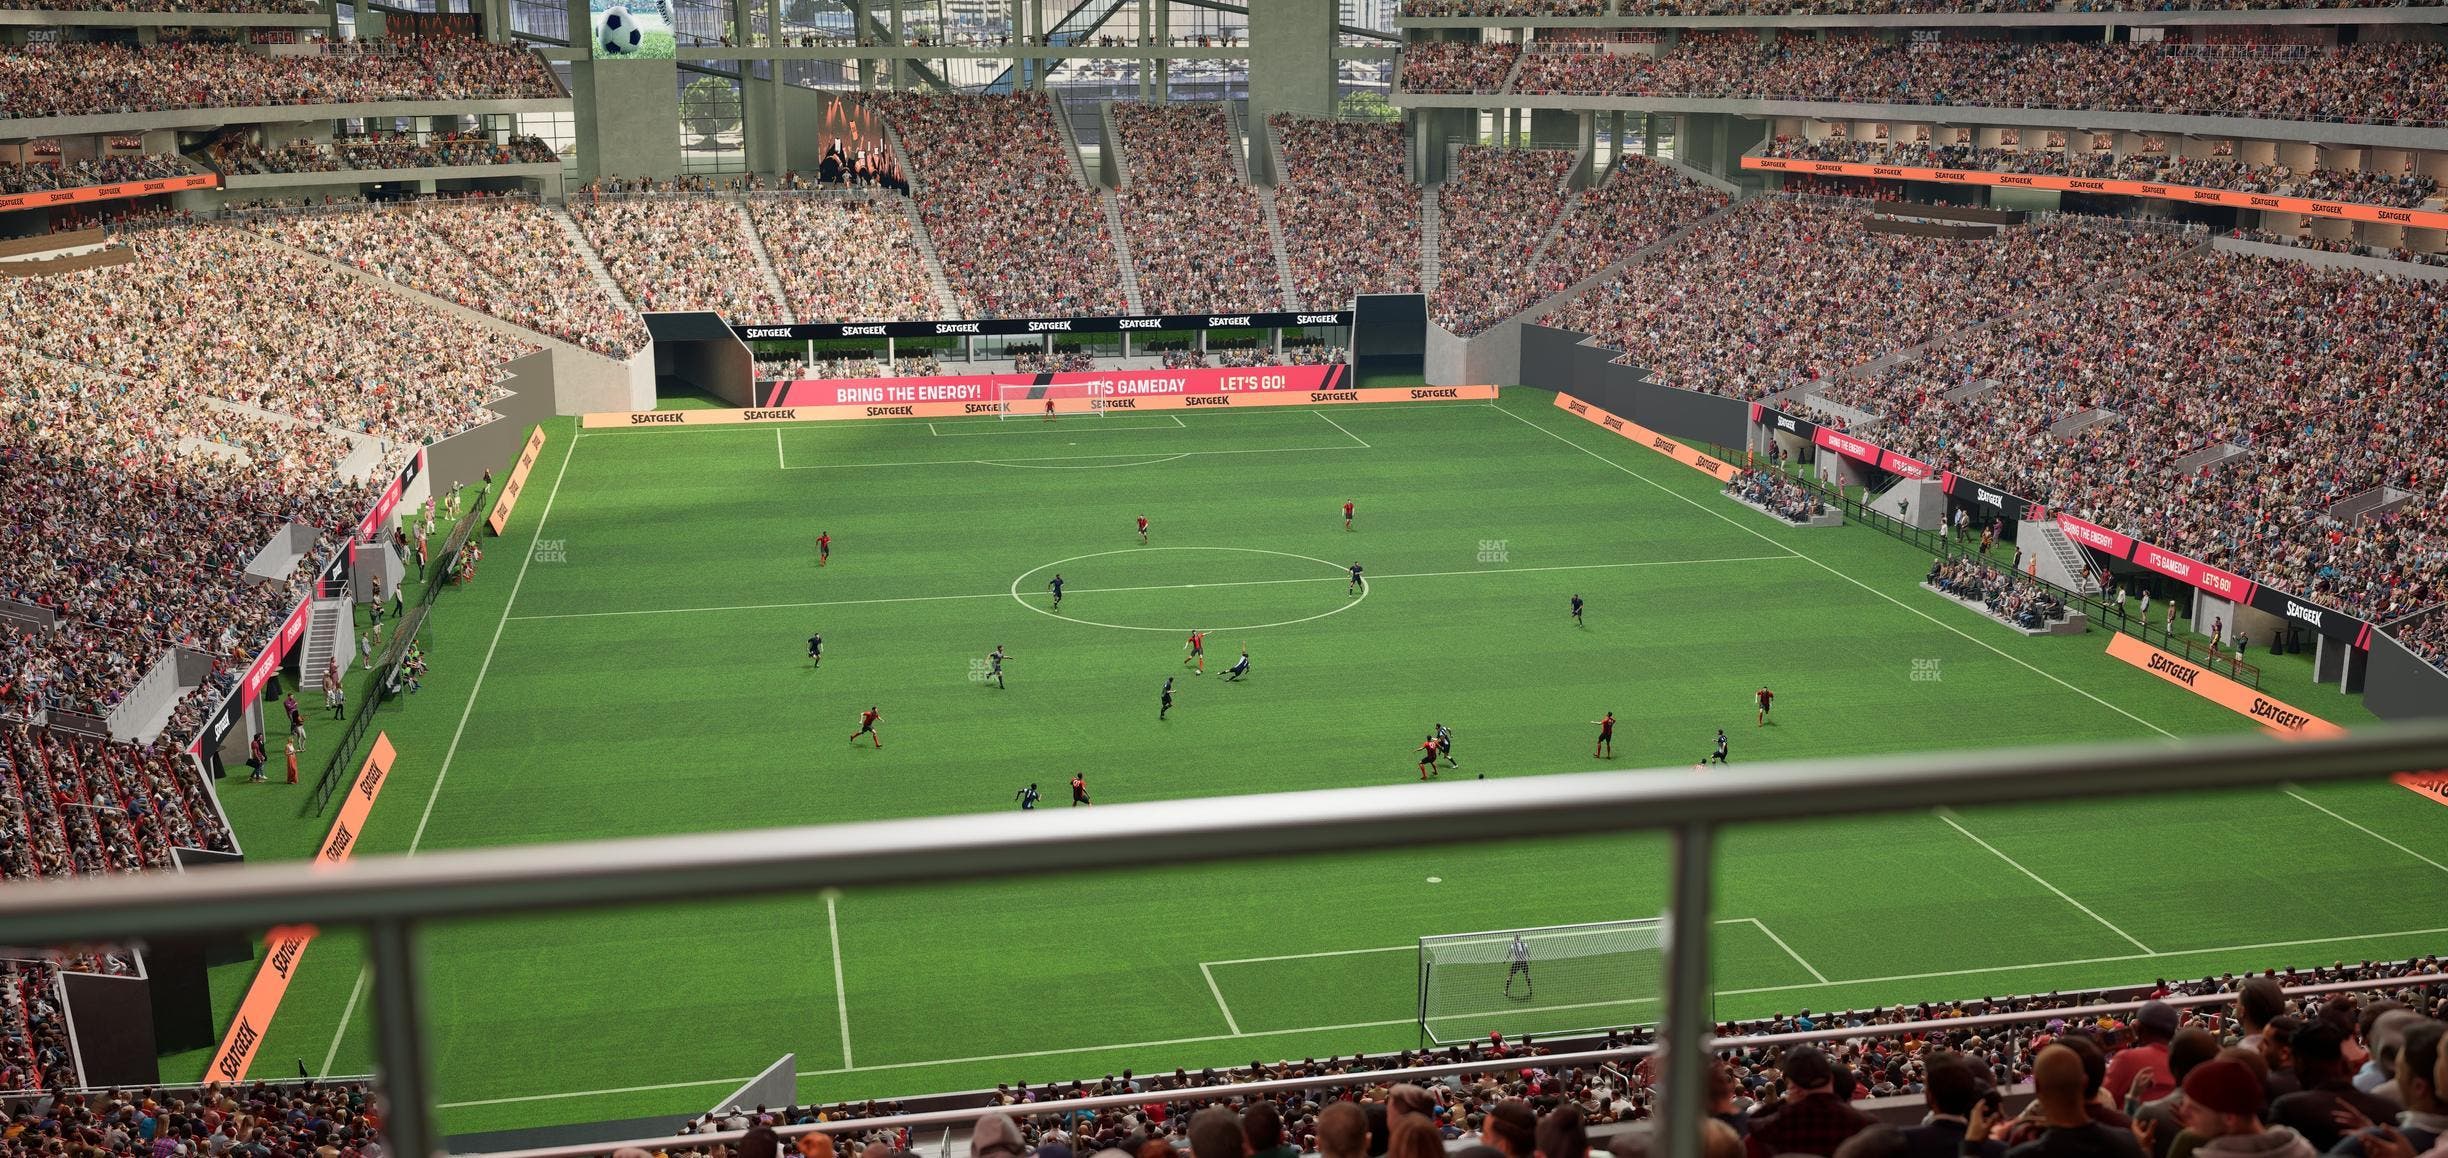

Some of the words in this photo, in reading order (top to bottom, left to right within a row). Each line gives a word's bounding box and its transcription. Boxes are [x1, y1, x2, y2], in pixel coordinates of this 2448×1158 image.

[1760, 160, 1787, 169] SEATGEEK
[1815, 164, 1843, 173] SEATGEEK
[1873, 167, 1902, 176] SEATGEEK
[1935, 171, 1966, 181] SEATGEEK
[2000, 176, 2033, 185] SEATGEEK
[2070, 180, 2104, 190] SEATGEEK
[98, 186, 121, 197] SEATGEEK
[144, 182, 165, 192] SEATGEEK
[2141, 185, 2167, 195] SEATGEEK
[50, 192, 75, 202] SEATGEEK
[2194, 190, 2221, 201] SEATGEEK
[2250, 196, 2280, 208] SEATGEEK
[2311, 203, 2342, 214] SEATGEEK
[2377, 210, 2411, 222] SEATGEEK
[1119, 318, 1162, 329] SEATGEEK
[1208, 316, 1251, 327] SEATGEEK
[1296, 314, 1338, 325] SEATGEEK
[842, 325, 887, 336] SEATGEEK
[935, 322, 980, 334] SEATGEEK
[1028, 320, 1072, 331] SEATGEEK
[746, 327, 792, 338] SEATGEEK
[1117, 378, 1186, 394] GAMEDAY
[1261, 375, 1286, 390] GO!
[837, 387, 885, 403] BRING
[887, 386, 916, 401] THE
[918, 384, 981, 400] ENERGY!
[1311, 390, 1358, 402] SEATGEEK
[1411, 388, 1458, 399] SEATGEEK
[1185, 395, 1230, 406] SEATGEEK
[866, 405, 913, 417] SEATGEEK
[965, 402, 1010, 414] SEATGEEK
[631, 412, 684, 424] SEATGEEK
[743, 408, 796, 421] SEATGEEK
[1653, 437, 1677, 455] SEATGEEK
[1695, 455, 1721, 474] SEATGEEK
[1977, 487, 2003, 510] SEATGEEK
[2080, 526, 2090, 540] THE
[2090, 529, 2113, 549] ENERGY!
[2161, 556, 2190, 577] GAMEDAY
[2286, 600, 2322, 628] SEATGEEK
[2147, 652, 2200, 687] SEATGEEK
[360, 758, 384, 801] SEATGEEK
[219, 1015, 258, 1085] SEATGEEK
